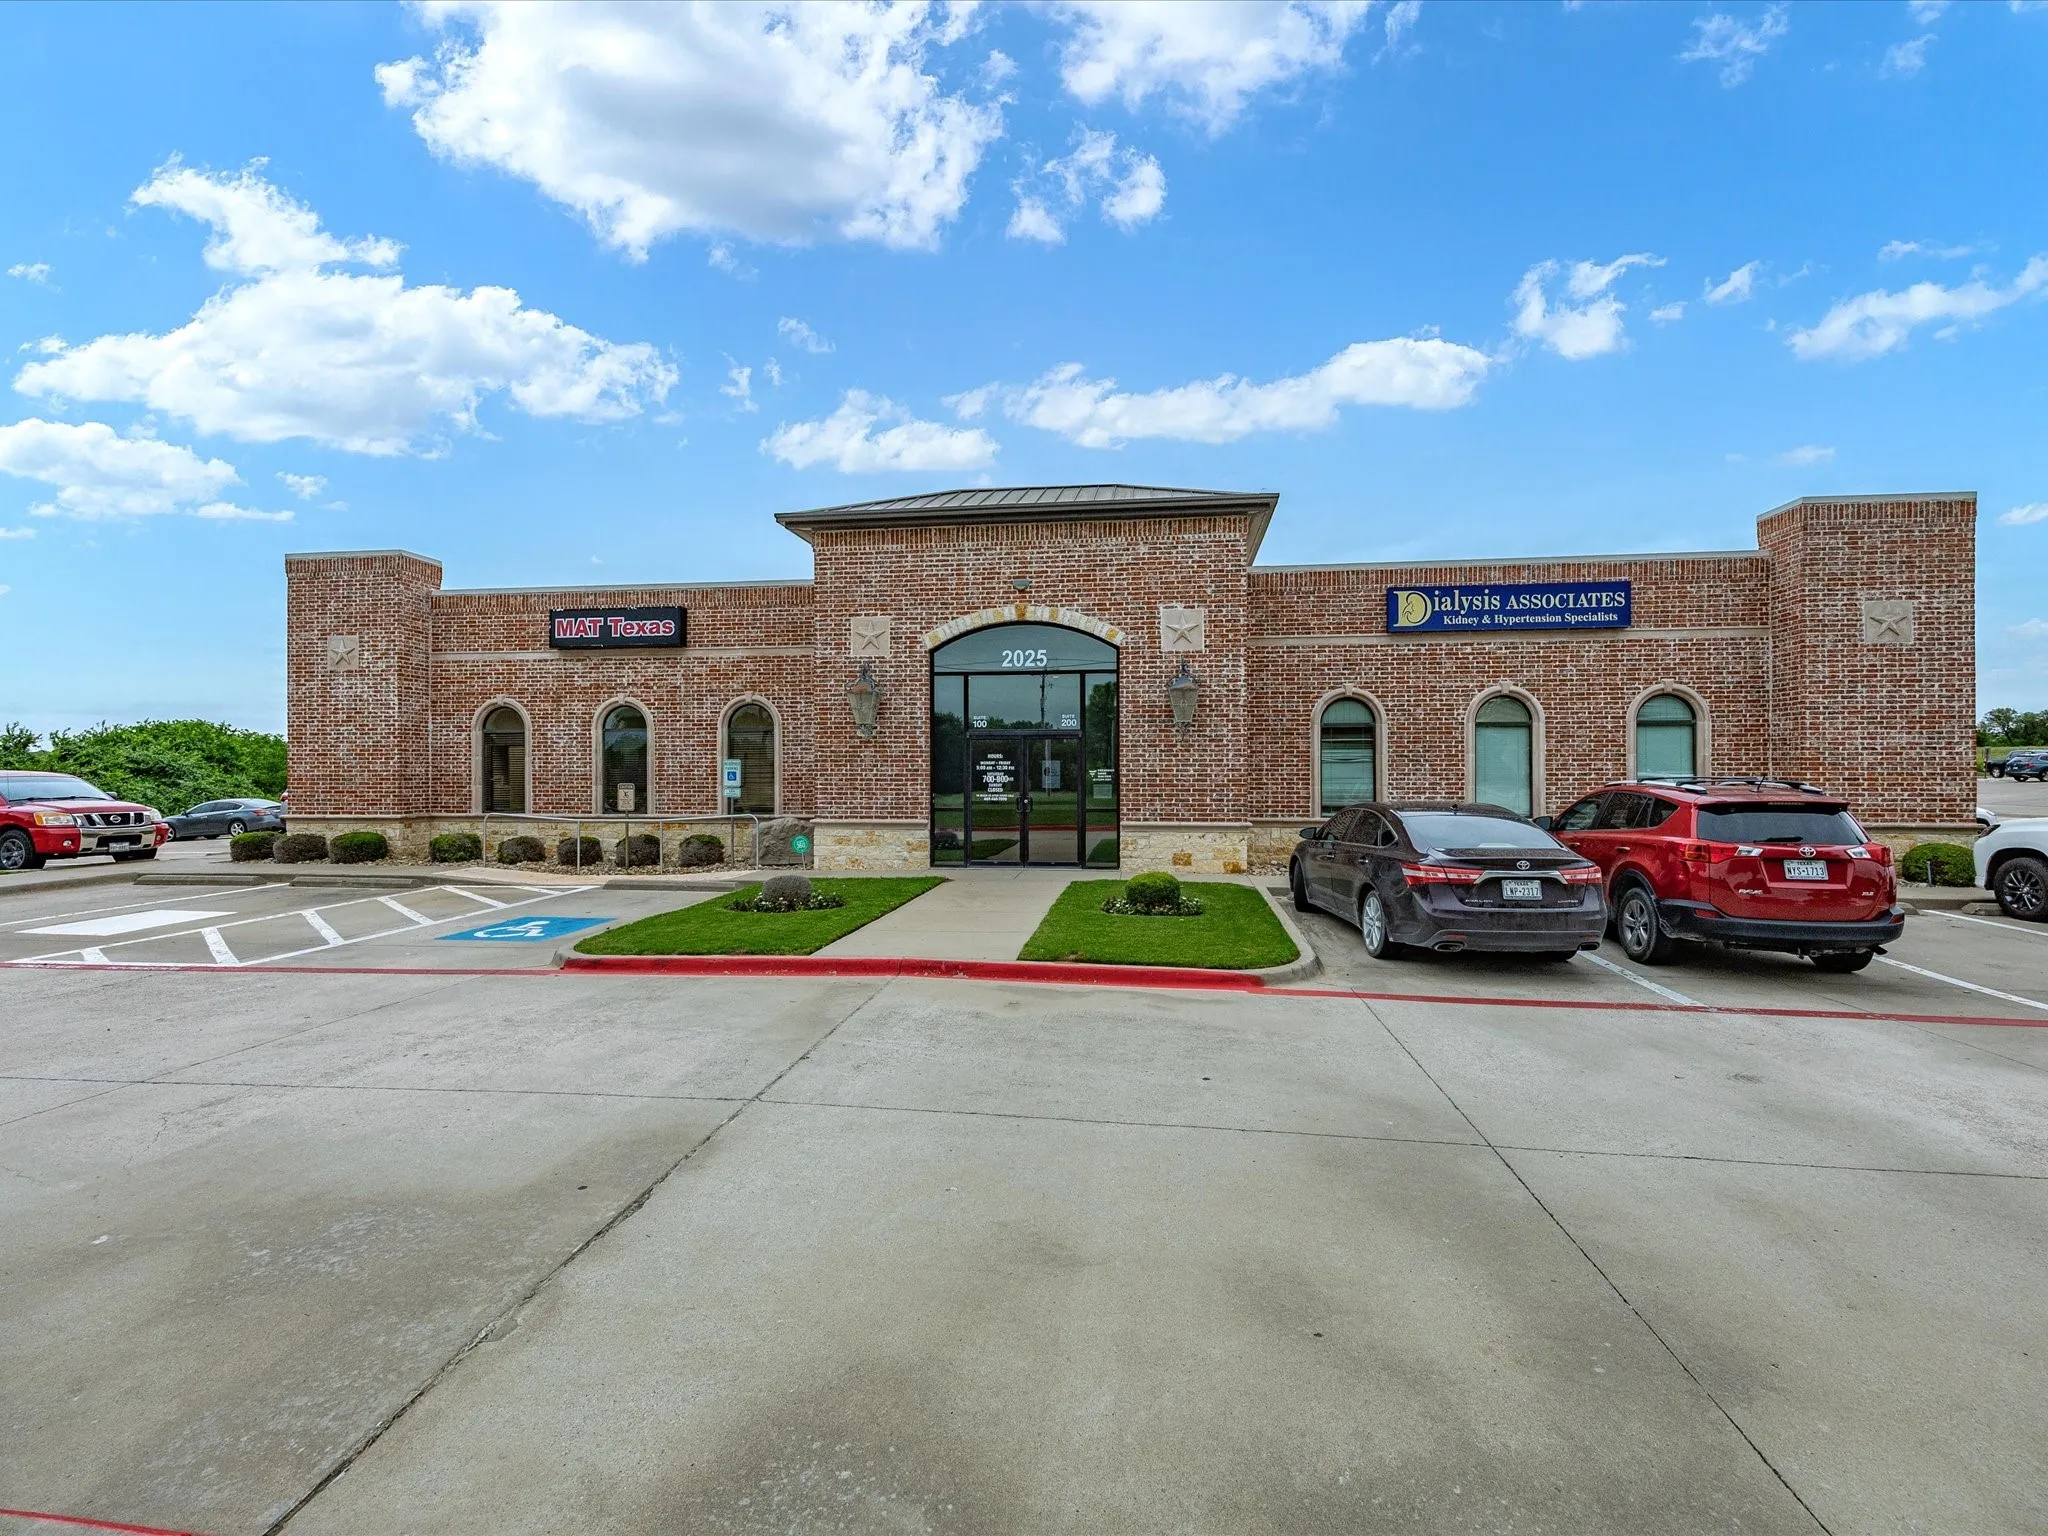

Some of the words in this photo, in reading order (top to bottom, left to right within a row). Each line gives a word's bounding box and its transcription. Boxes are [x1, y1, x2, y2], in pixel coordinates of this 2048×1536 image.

[1393, 588, 1501, 627] Dialysis
[1505, 591, 1626, 610] ASSOCIATES
[555, 617, 604, 639] MAT
[607, 616, 675, 637] Texas
[1443, 615, 1480, 627] Kidney
[1482, 614, 1491, 624] &
[1494, 613, 1562, 626] Hypertension
[1564, 611, 1618, 624] Specialists
[1001, 649, 1048, 668] 2025
[972, 720, 988, 728] 100
[1061, 718, 1077, 727] 200
